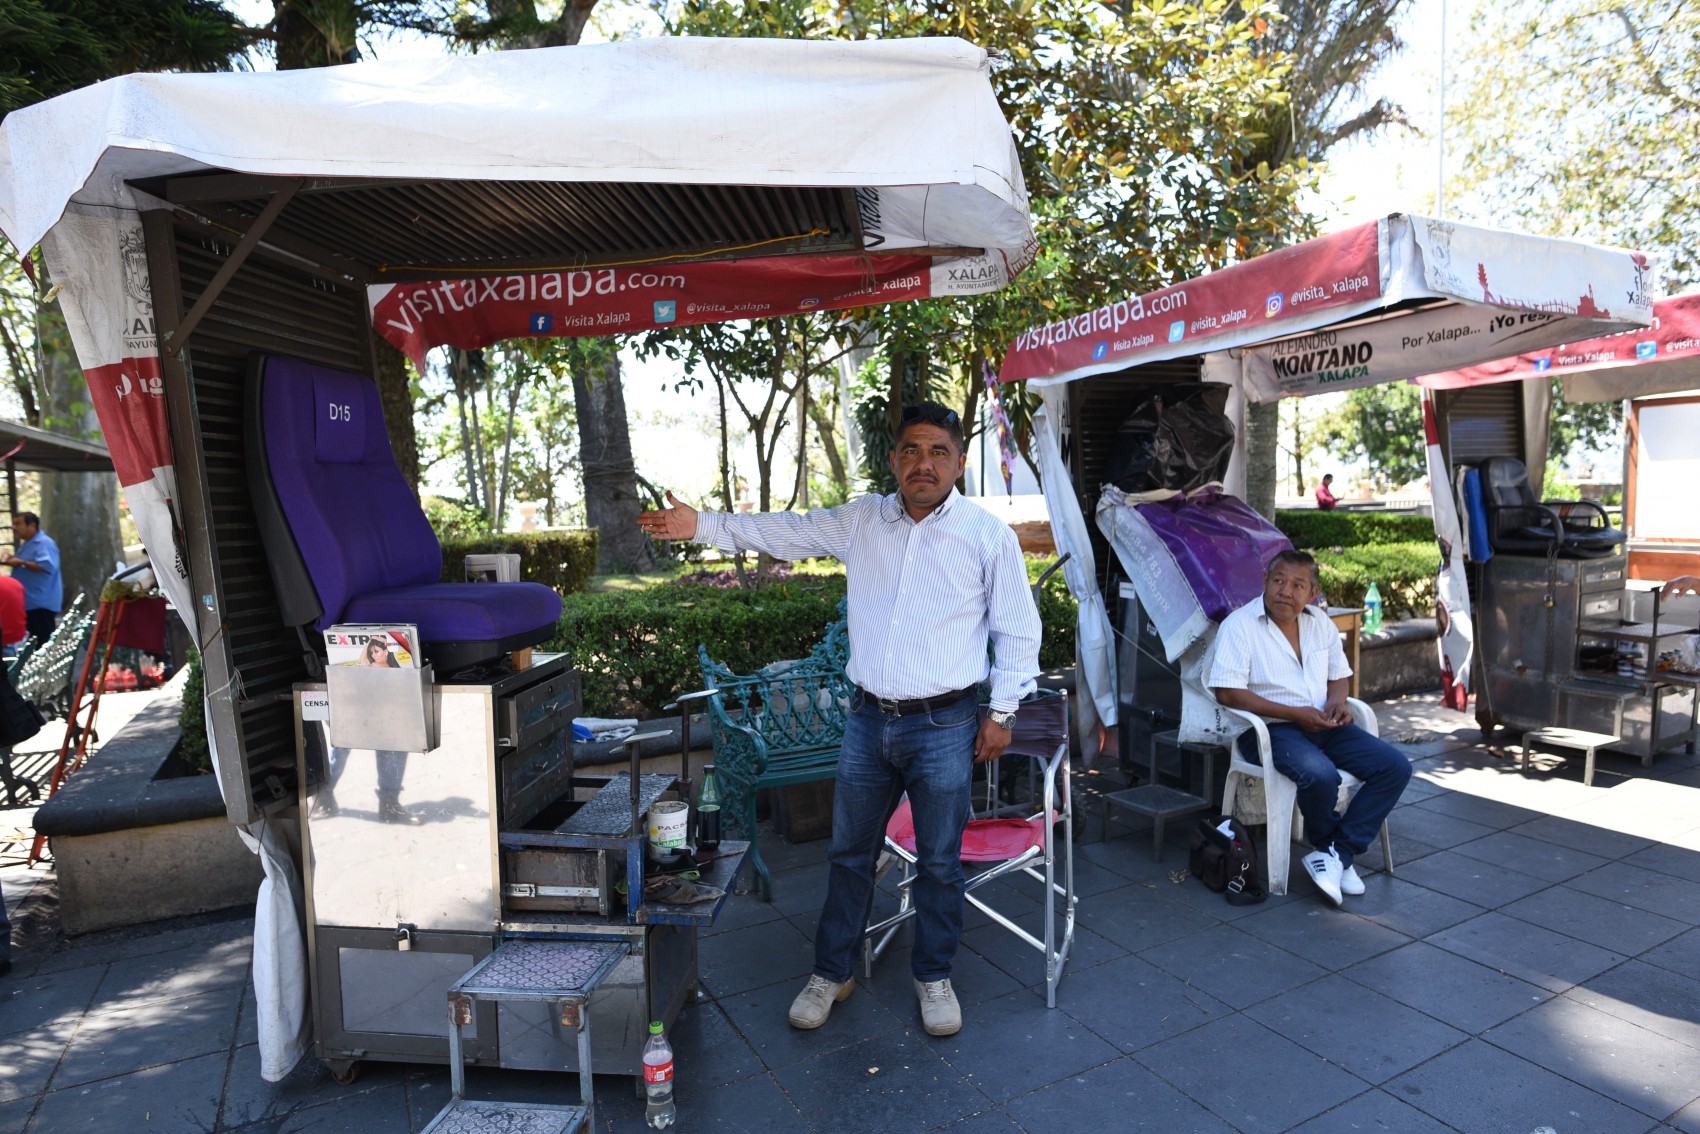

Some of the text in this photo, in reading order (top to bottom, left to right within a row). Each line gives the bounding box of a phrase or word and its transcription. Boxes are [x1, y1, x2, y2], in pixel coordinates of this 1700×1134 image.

[948, 263, 999, 281] XALAPA
[882, 275, 921, 291] xalapa
[1332, 275, 1368, 294] xalapa
[387, 267, 685, 335] visitaxalapa.com
[686, 302, 771, 315] @visita_xalapa
[564, 311, 631, 327] Visita Xalapa
[1016, 290, 1187, 352] visitaxalapa.com
[1191, 308, 1247, 334] @visita_xalapa
[1113, 333, 1154, 352] Visita Xalapa
[1272, 331, 1337, 356] ALEJANDRO
[1402, 336, 1424, 350] Por
[1426, 325, 1481, 345] Xalapa...
[1272, 341, 1373, 379] MONTANO
[1558, 351, 1615, 366] Visita Xalapa
[1318, 365, 1369, 385] XALAPA
[329, 402, 351, 422] D15
